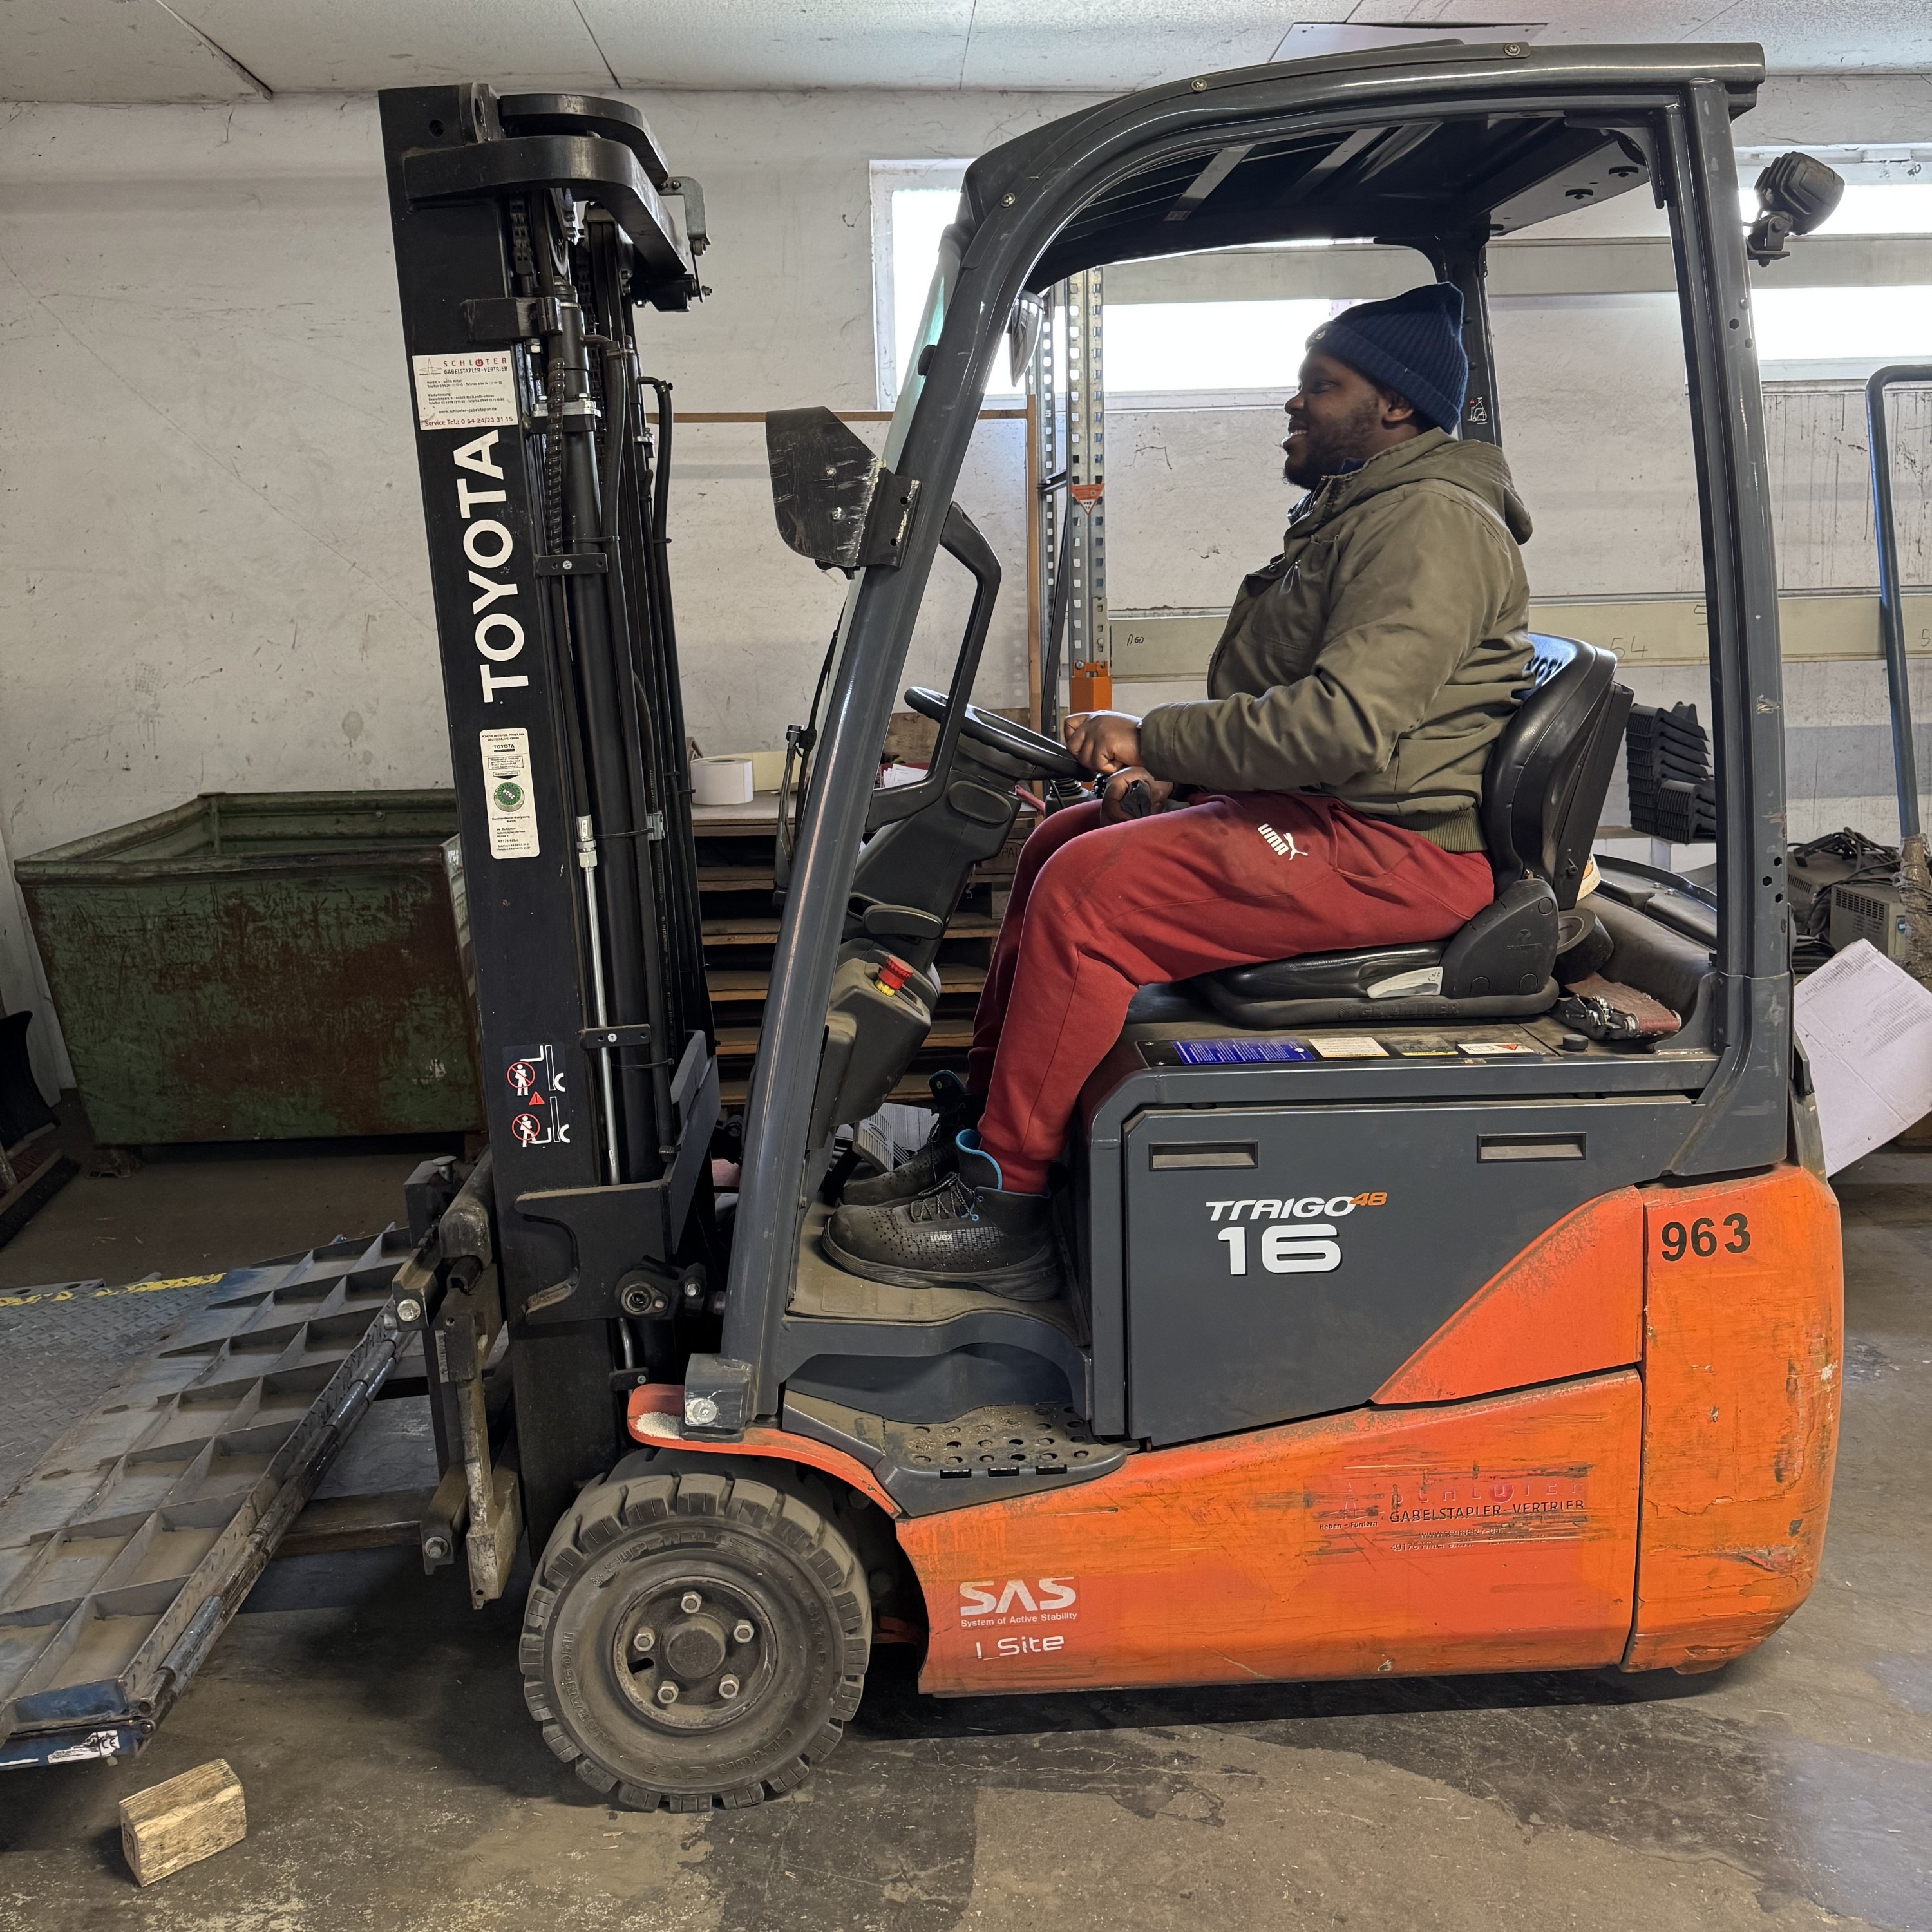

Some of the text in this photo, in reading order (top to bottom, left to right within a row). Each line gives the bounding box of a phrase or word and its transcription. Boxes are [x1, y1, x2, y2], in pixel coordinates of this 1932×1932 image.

[444, 366, 507, 375] GABELSTAPLER-VERTRIEB
[453, 429, 529, 703] TOYOTA
[1610, 636, 1648, 658] 54
[1257, 823, 1289, 856] PUMA
[1218, 1224, 1341, 1275] 16
[1662, 1213, 1751, 1262] 963
[960, 1577, 1077, 1616] SAS
[961, 1612, 1077, 1627] System of Active Stability
